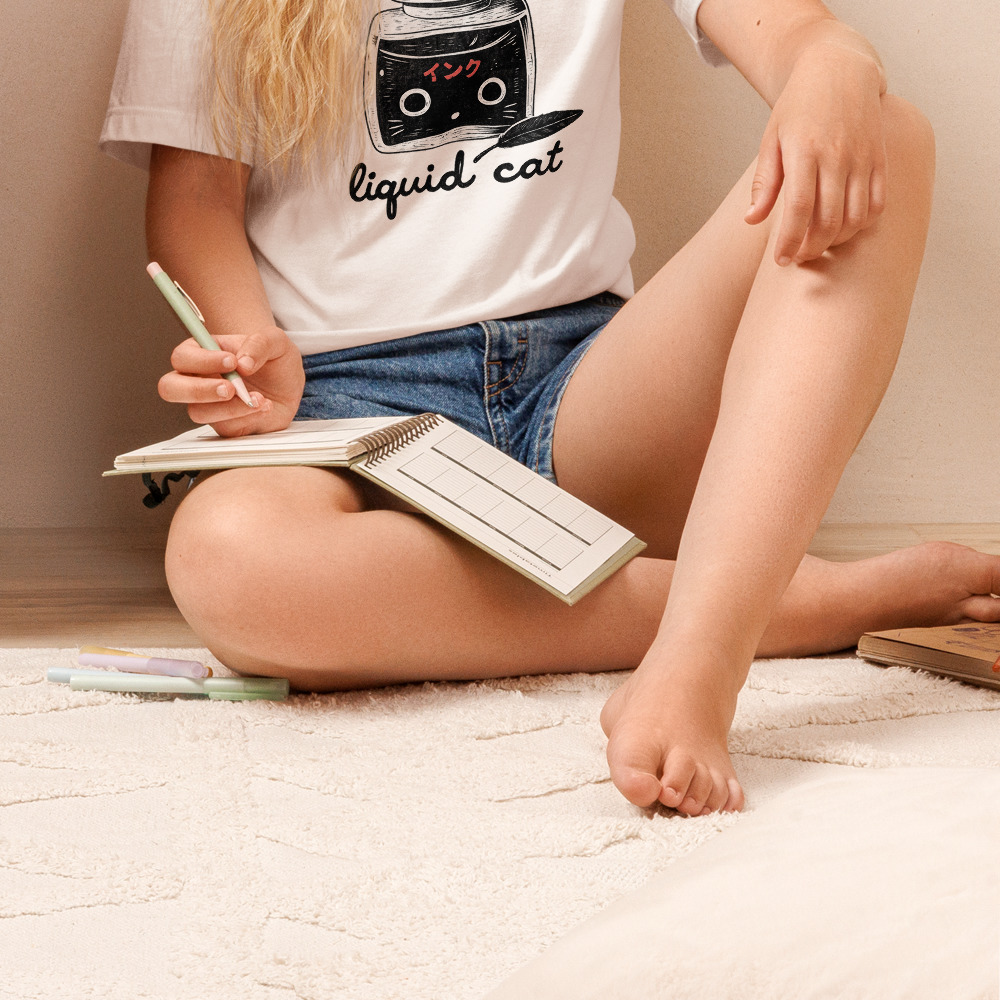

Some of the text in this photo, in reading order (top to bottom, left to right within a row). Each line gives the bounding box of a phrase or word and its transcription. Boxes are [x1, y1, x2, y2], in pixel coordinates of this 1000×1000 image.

[424, 59, 480, 82] インク
[349, 140, 563, 220] liquid cat
